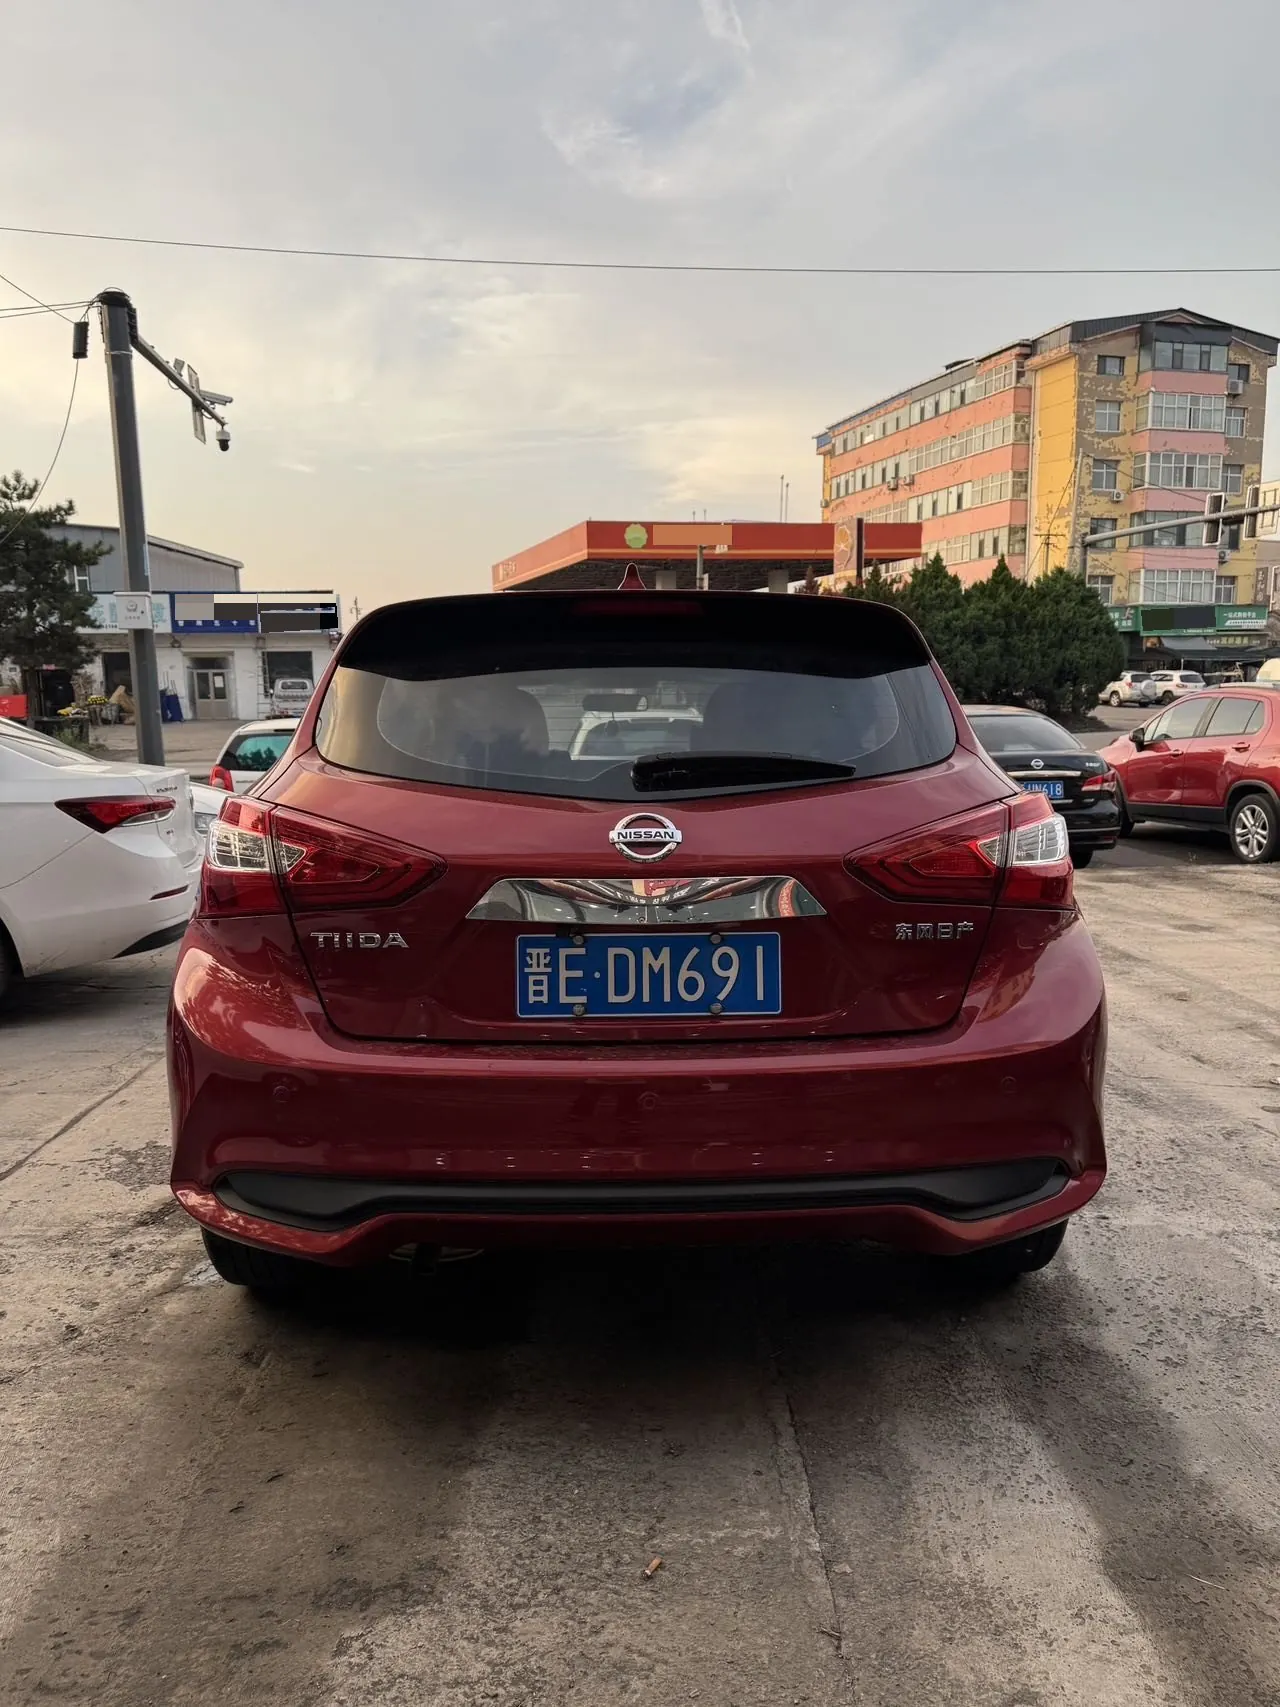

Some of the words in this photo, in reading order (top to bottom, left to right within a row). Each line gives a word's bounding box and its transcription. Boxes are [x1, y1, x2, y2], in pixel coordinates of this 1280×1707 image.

[617, 831, 674, 840] NISSAN
[895, 921, 974, 940] 东风日产
[310, 932, 409, 949] TIIDA
